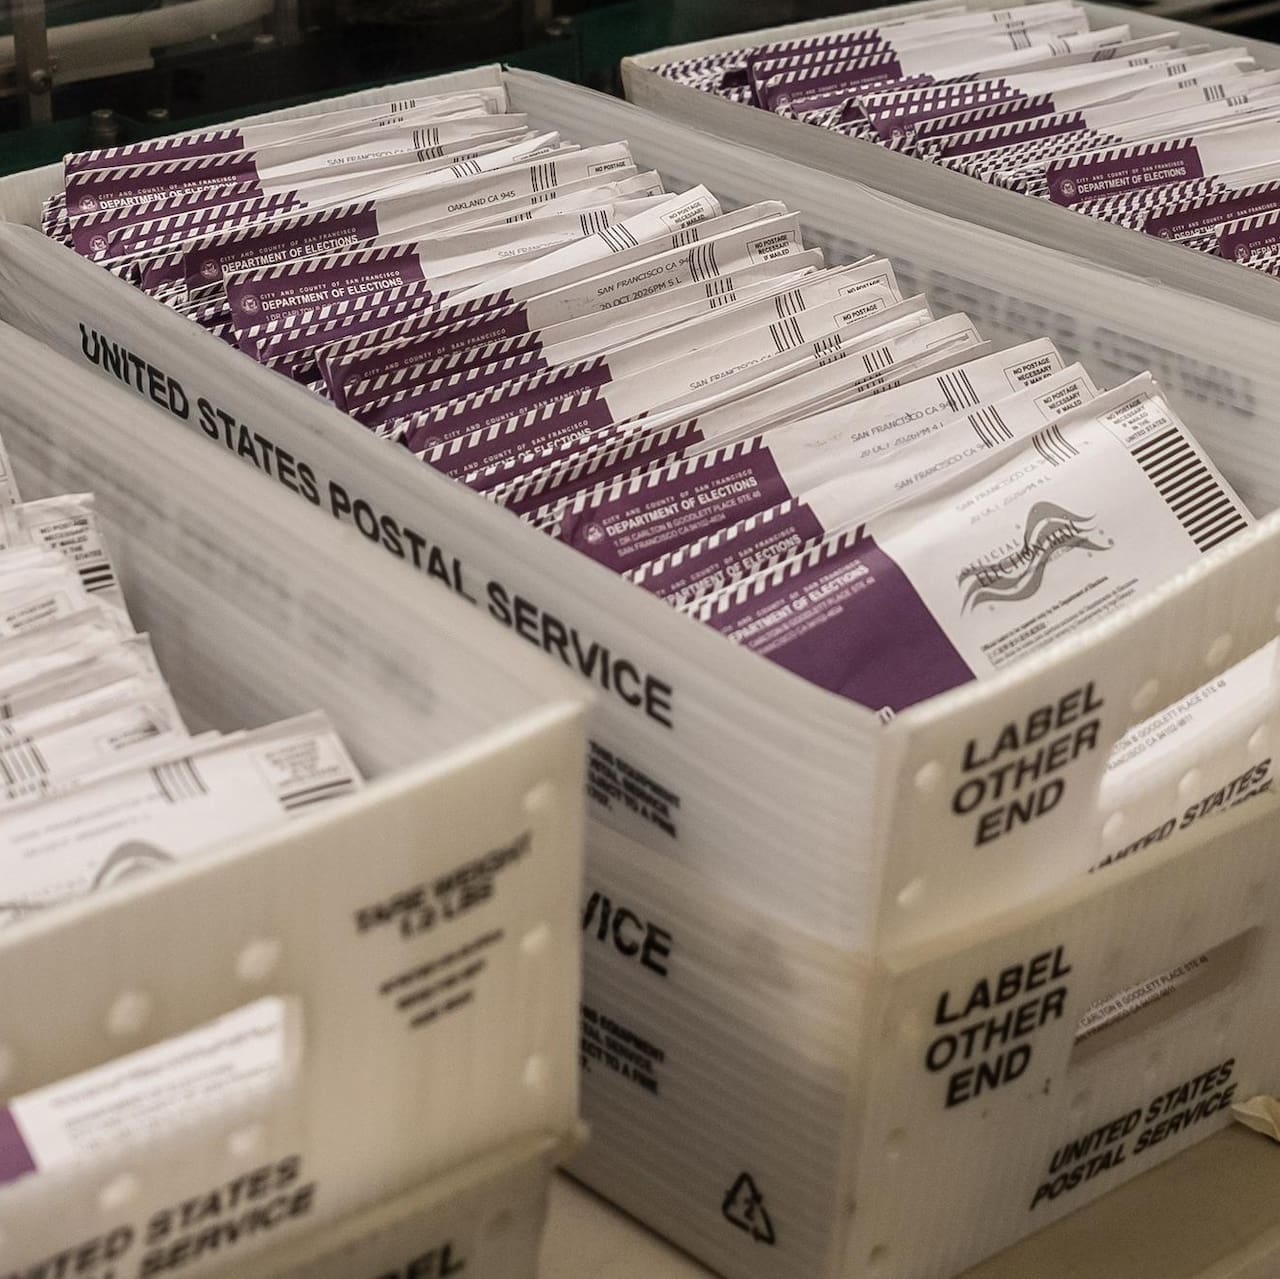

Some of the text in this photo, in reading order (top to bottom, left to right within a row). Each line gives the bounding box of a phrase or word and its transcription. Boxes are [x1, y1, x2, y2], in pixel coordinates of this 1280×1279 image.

[1077, 176, 1131, 195] DEPARTMENT
[1131, 173, 1143, 184] OF
[1144, 167, 1187, 184] ELECTIONS
[1107, 170, 1129, 179] COUNTY
[1154, 161, 1184, 170] FRANCISCO
[447, 190, 516, 212] OAKLAND CA 945
[221, 234, 358, 273] DEPARTMENT OF ELECTIONS
[259, 244, 285, 255] COUNTY
[319, 227, 357, 240] FRANCISCO
[261, 276, 403, 312] DEPARTMENT OF ELECTIONS
[300, 282, 327, 292] COUNTY
[361, 270, 400, 281] FRANCISCO
[597, 261, 677, 296] SAN FRANCISCO CA
[612, 295, 631, 308] OCT
[1049, 392, 1081, 410] NECESSARY
[1052, 383, 1079, 400] POSTAGE
[1116, 399, 1141, 417] POSTAGE
[851, 431, 870, 443] SAN
[871, 410, 924, 436] FRANCISCO
[1113, 405, 1145, 425] NECESSARY
[895, 478, 914, 491] SAN
[915, 453, 963, 482] FRANCISCO
[606, 475, 758, 537] DEPARTMENT OF ELECTIONS
[79, 323, 676, 729] UNITED STATES POSTAL SERVICE
[976, 520, 1081, 588] ELECTION MAIL
[961, 681, 1105, 773] LABEL
[952, 719, 1100, 815] OTHER
[974, 779, 1066, 848] END
[1179, 758, 1271, 830] STATES
[934, 945, 1072, 1027] LABEL
[924, 987, 1068, 1074] OTHER
[943, 1044, 1033, 1111] END
[1047, 1058, 1237, 1176] UNITED STATES
[1029, 1083, 1239, 1211] POSTAL SERVICE
[146, 1154, 303, 1247] STATES
[139, 1181, 318, 1279] SERVICE
